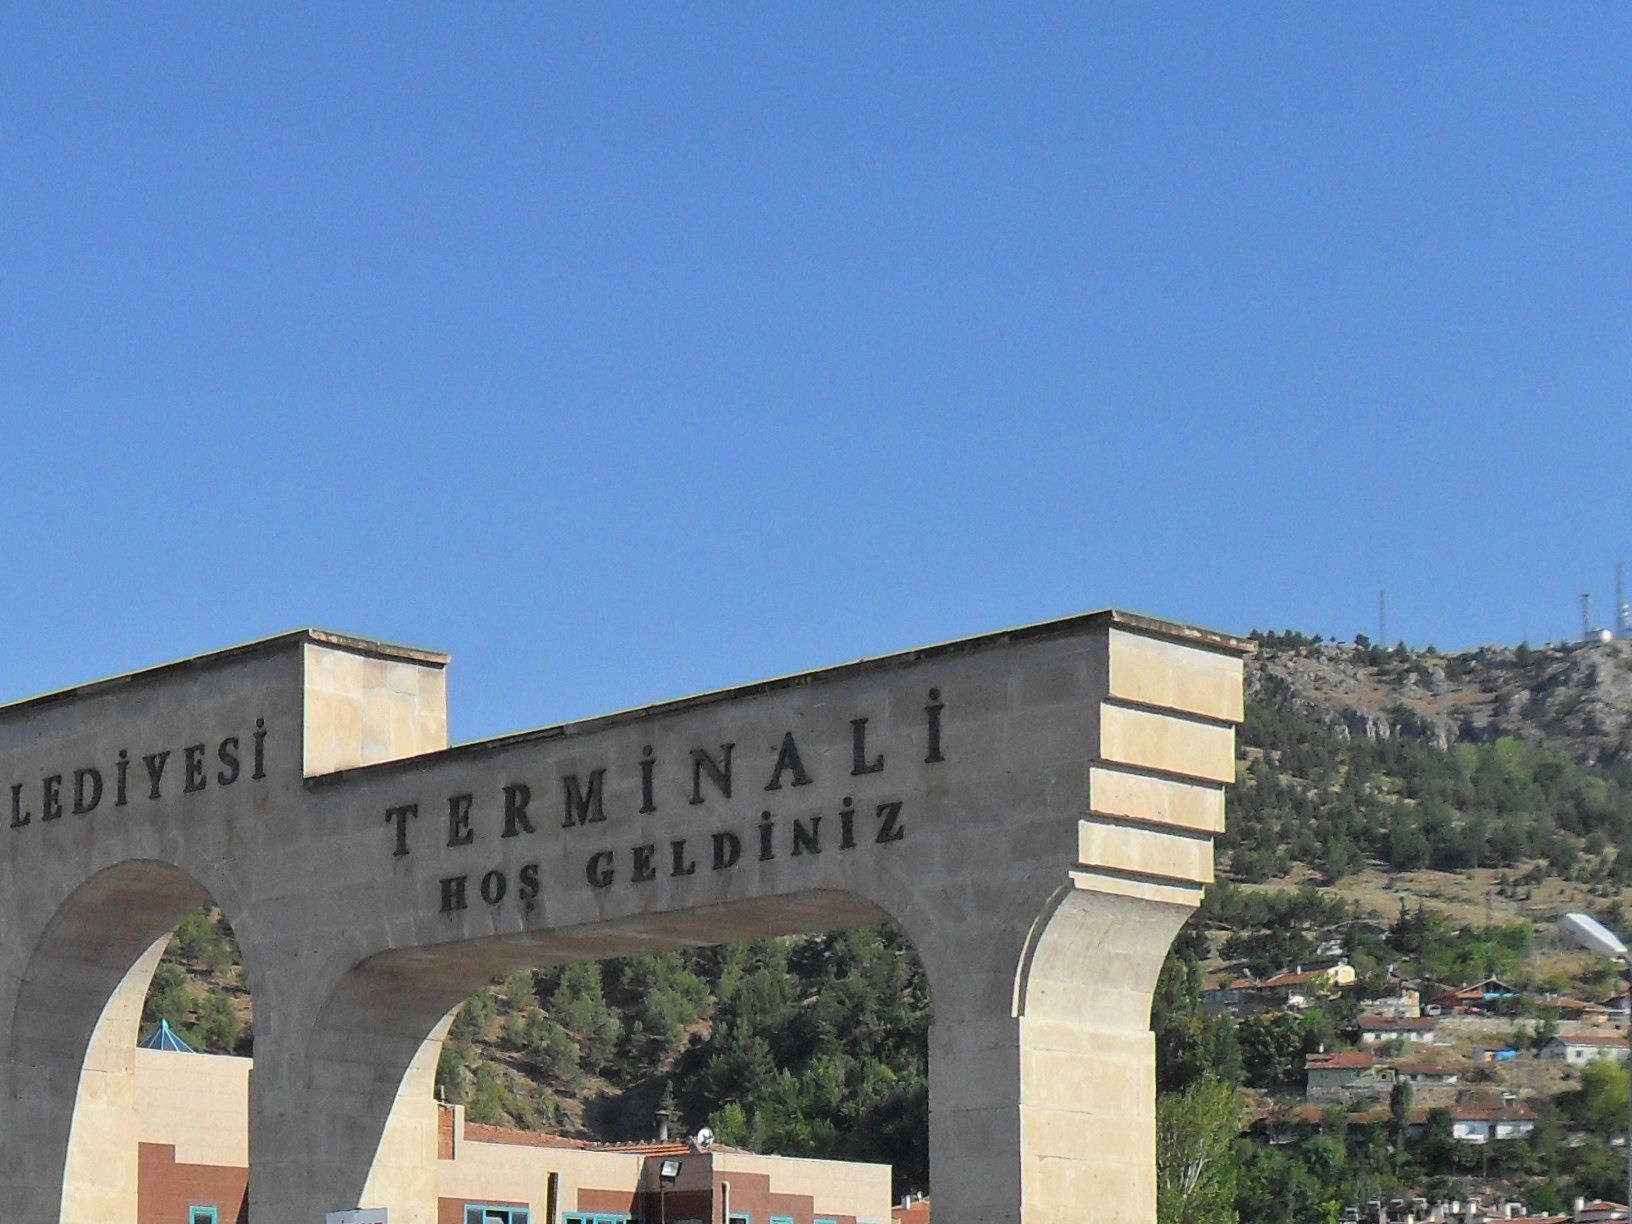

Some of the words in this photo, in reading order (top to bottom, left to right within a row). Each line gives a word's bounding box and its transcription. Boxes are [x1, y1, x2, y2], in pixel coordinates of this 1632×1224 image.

[385, 686, 945, 857] TERMİNALİ
[439, 863, 540, 912] HOŞ
[585, 796, 906, 889] GELDİNİZ
